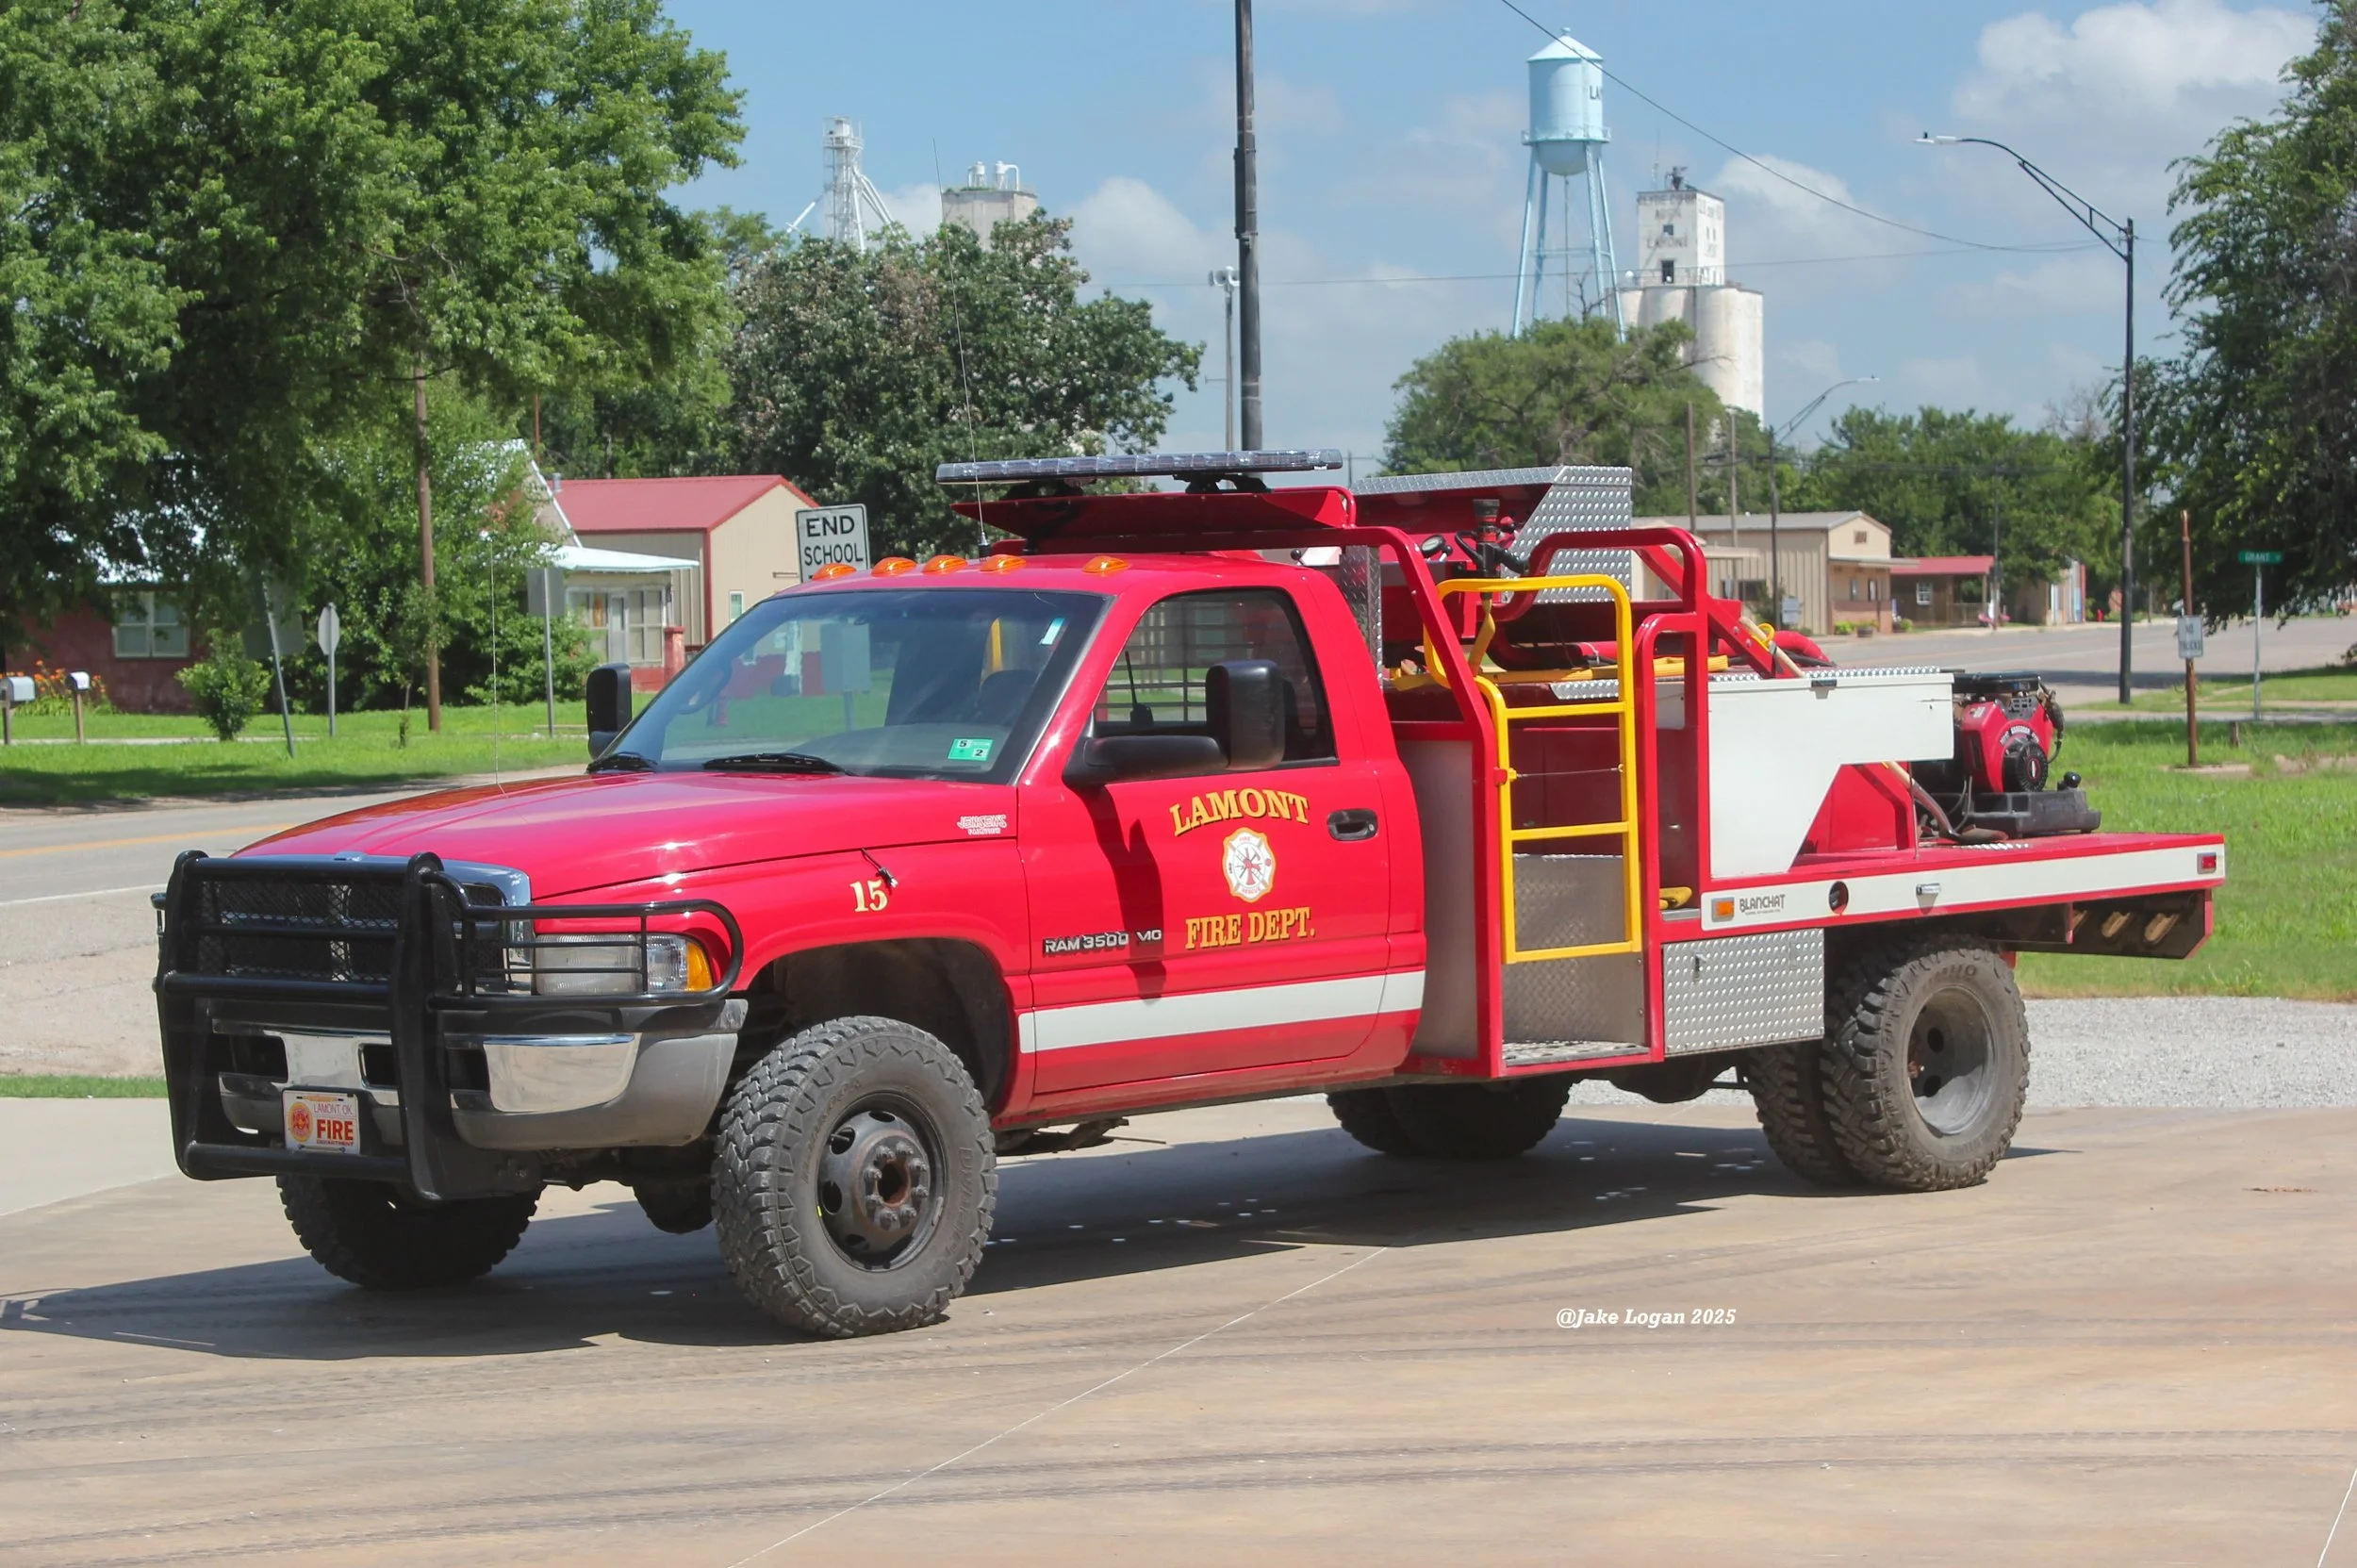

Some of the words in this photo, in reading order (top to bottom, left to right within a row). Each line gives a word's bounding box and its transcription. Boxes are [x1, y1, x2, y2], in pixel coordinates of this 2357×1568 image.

[806, 515, 855, 537] END
[804, 542, 864, 566] SCHOOL
[975, 749, 983, 757] 2
[1169, 787, 1310, 836] LAMONT
[849, 879, 888, 913] 15
[1739, 894, 1786, 913] BLANCHAT
[1185, 914, 1242, 949] FIRE
[1248, 906, 1316, 943] DEPT.
[1045, 939, 1080, 953] RAM
[1082, 933, 1129, 949] 3500
[1136, 929, 1162, 942] V10
[342, 1104, 353, 1115] OK
[317, 1119, 354, 1140] FIRE
